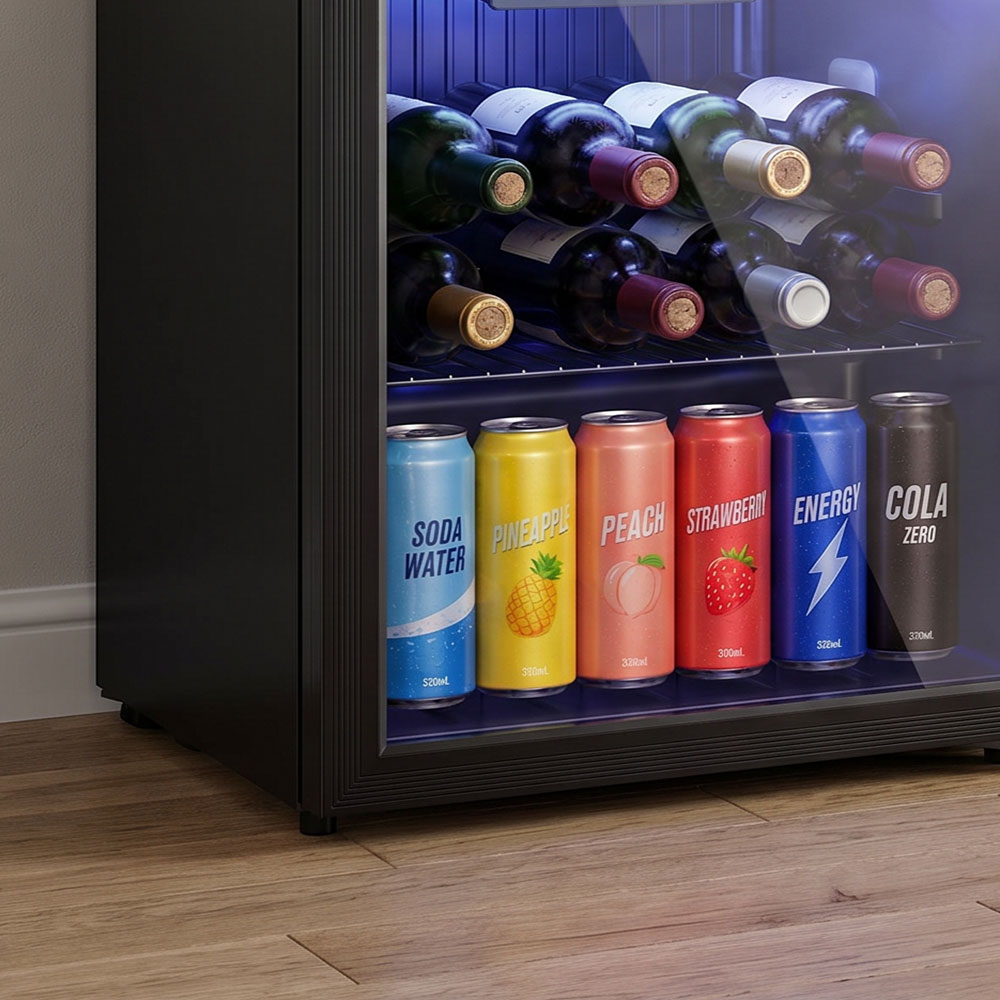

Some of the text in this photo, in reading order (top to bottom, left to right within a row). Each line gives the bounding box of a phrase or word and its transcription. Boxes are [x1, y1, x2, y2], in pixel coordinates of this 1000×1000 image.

[793, 482, 861, 526] ENERGY
[885, 482, 948, 521] COLA
[411, 516, 462, 548] SODA
[491, 503, 570, 554] PINEAPPLE
[601, 501, 666, 547] PEACH
[902, 525, 936, 545] ZERO
[405, 545, 466, 580] WATER
